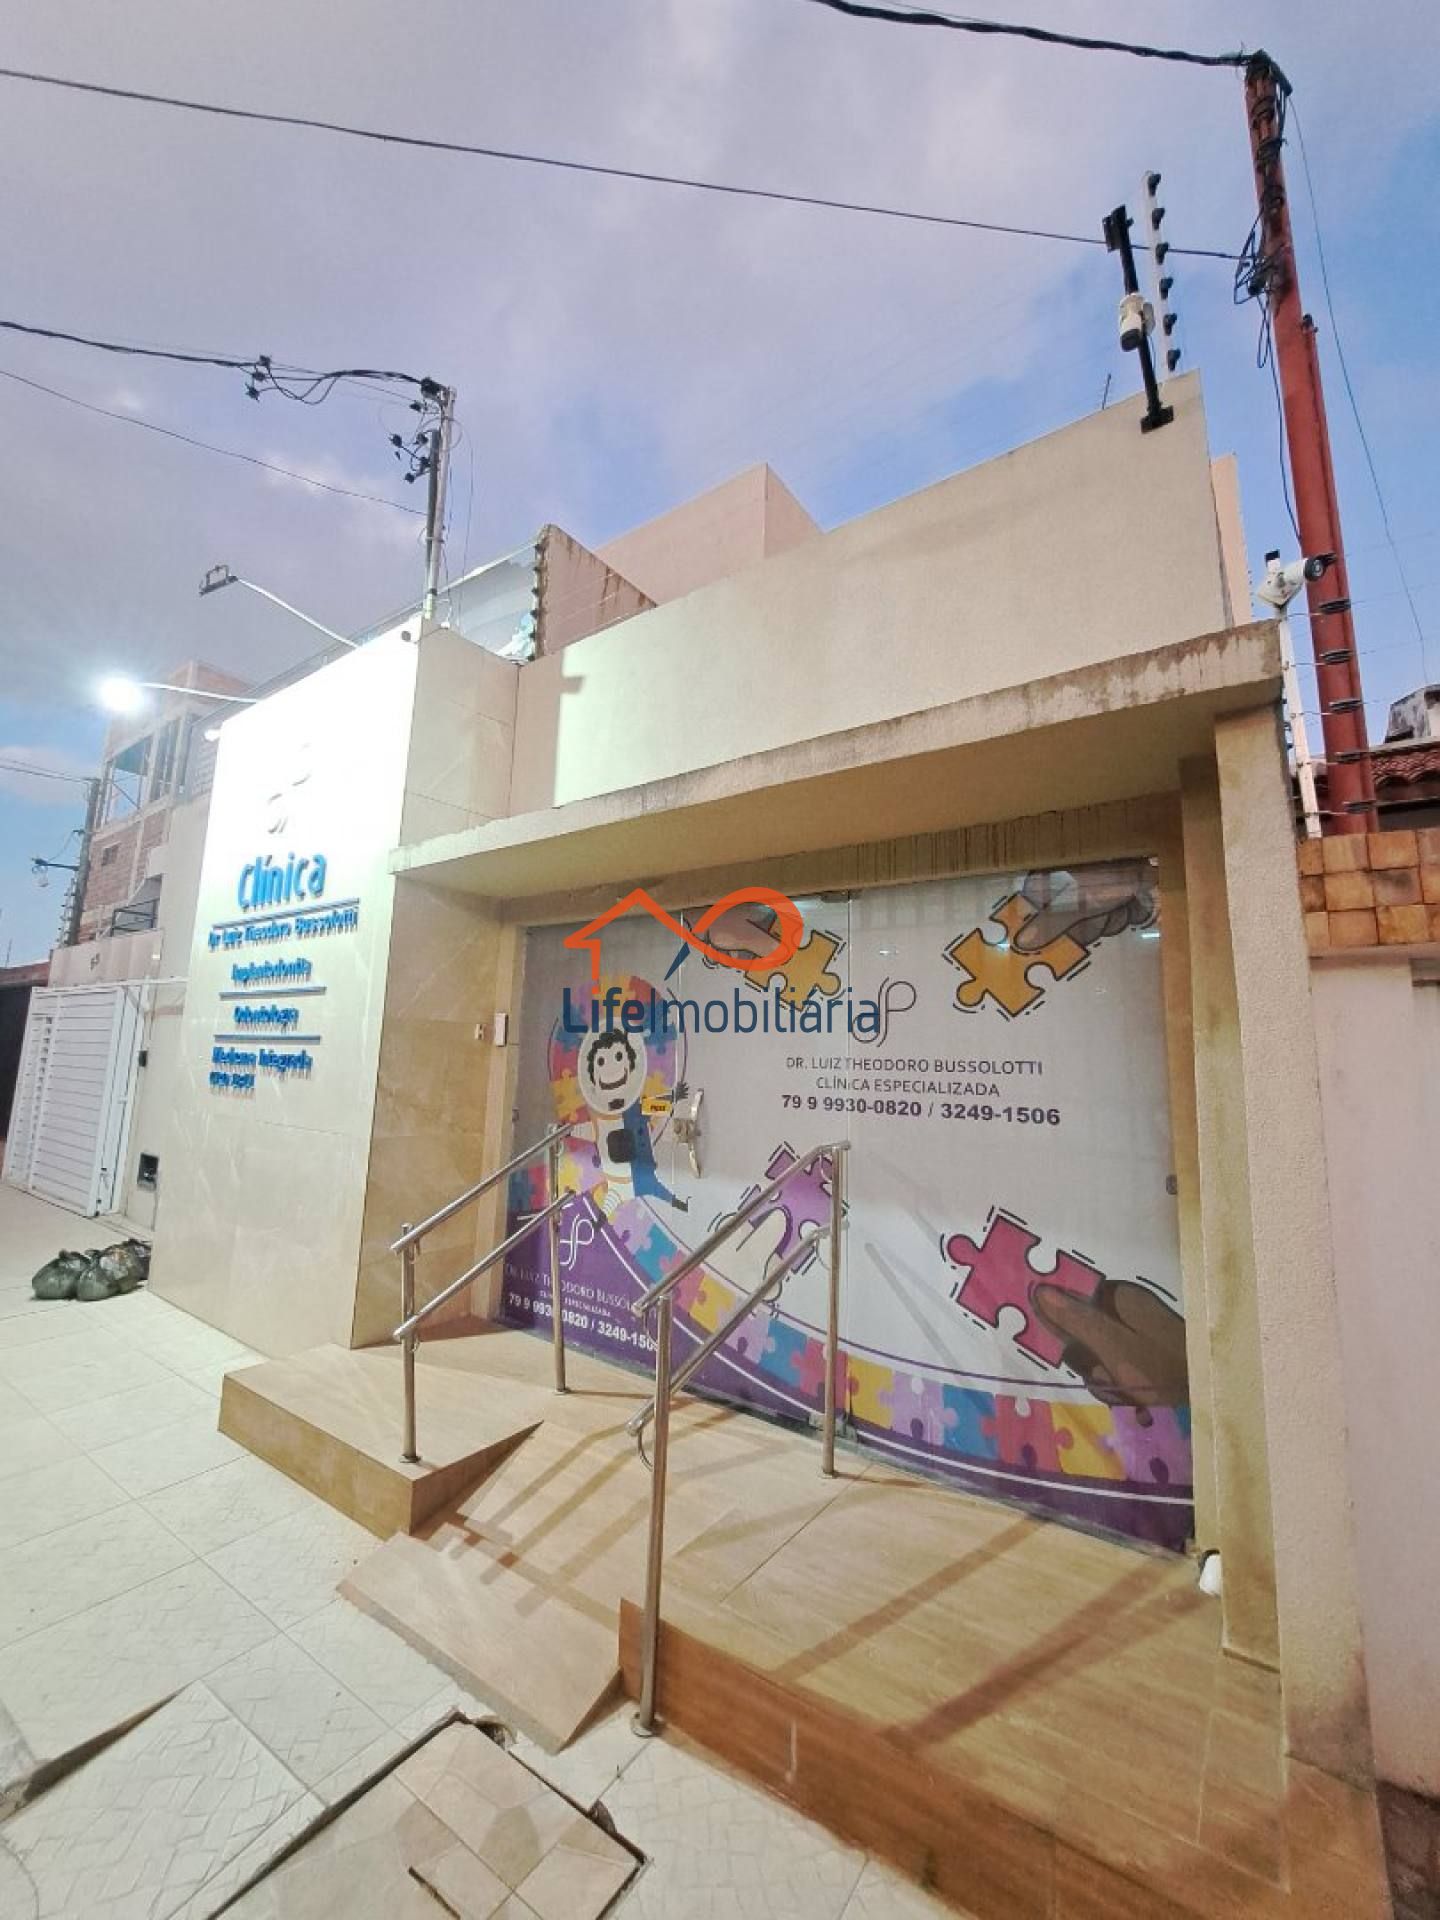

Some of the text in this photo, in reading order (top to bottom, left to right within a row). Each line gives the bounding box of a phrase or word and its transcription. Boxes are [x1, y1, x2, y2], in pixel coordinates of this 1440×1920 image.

[237, 852, 328, 911] Clínica
[786, 1057, 1043, 1076] DR. LUIZ THEODORO BUSSOLOTTI
[874, 1080, 1001, 1098] ESPECIALIZADA
[781, 1094, 1061, 1126] 79 9 9930-0820 / 3249-1506
